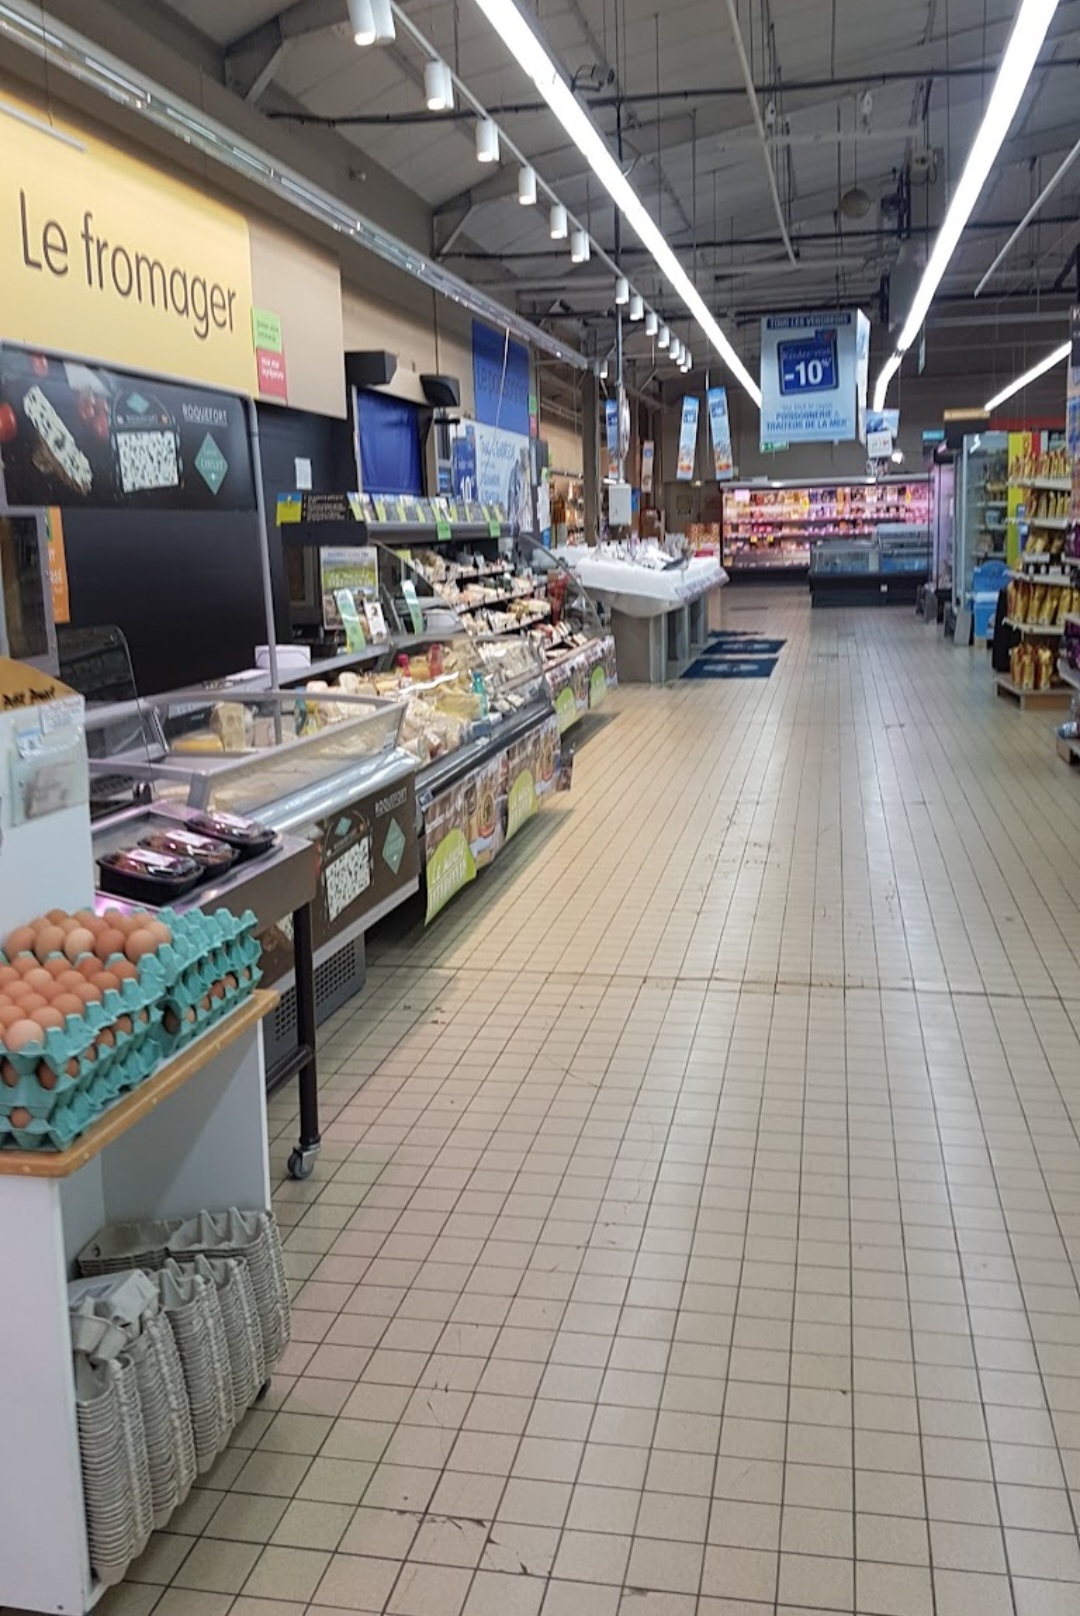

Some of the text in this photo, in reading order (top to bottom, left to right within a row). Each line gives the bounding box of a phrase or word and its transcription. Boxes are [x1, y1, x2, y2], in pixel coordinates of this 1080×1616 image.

[19, 187, 237, 340] Le fromager
[182, 403, 228, 425] ROQUEFORT
